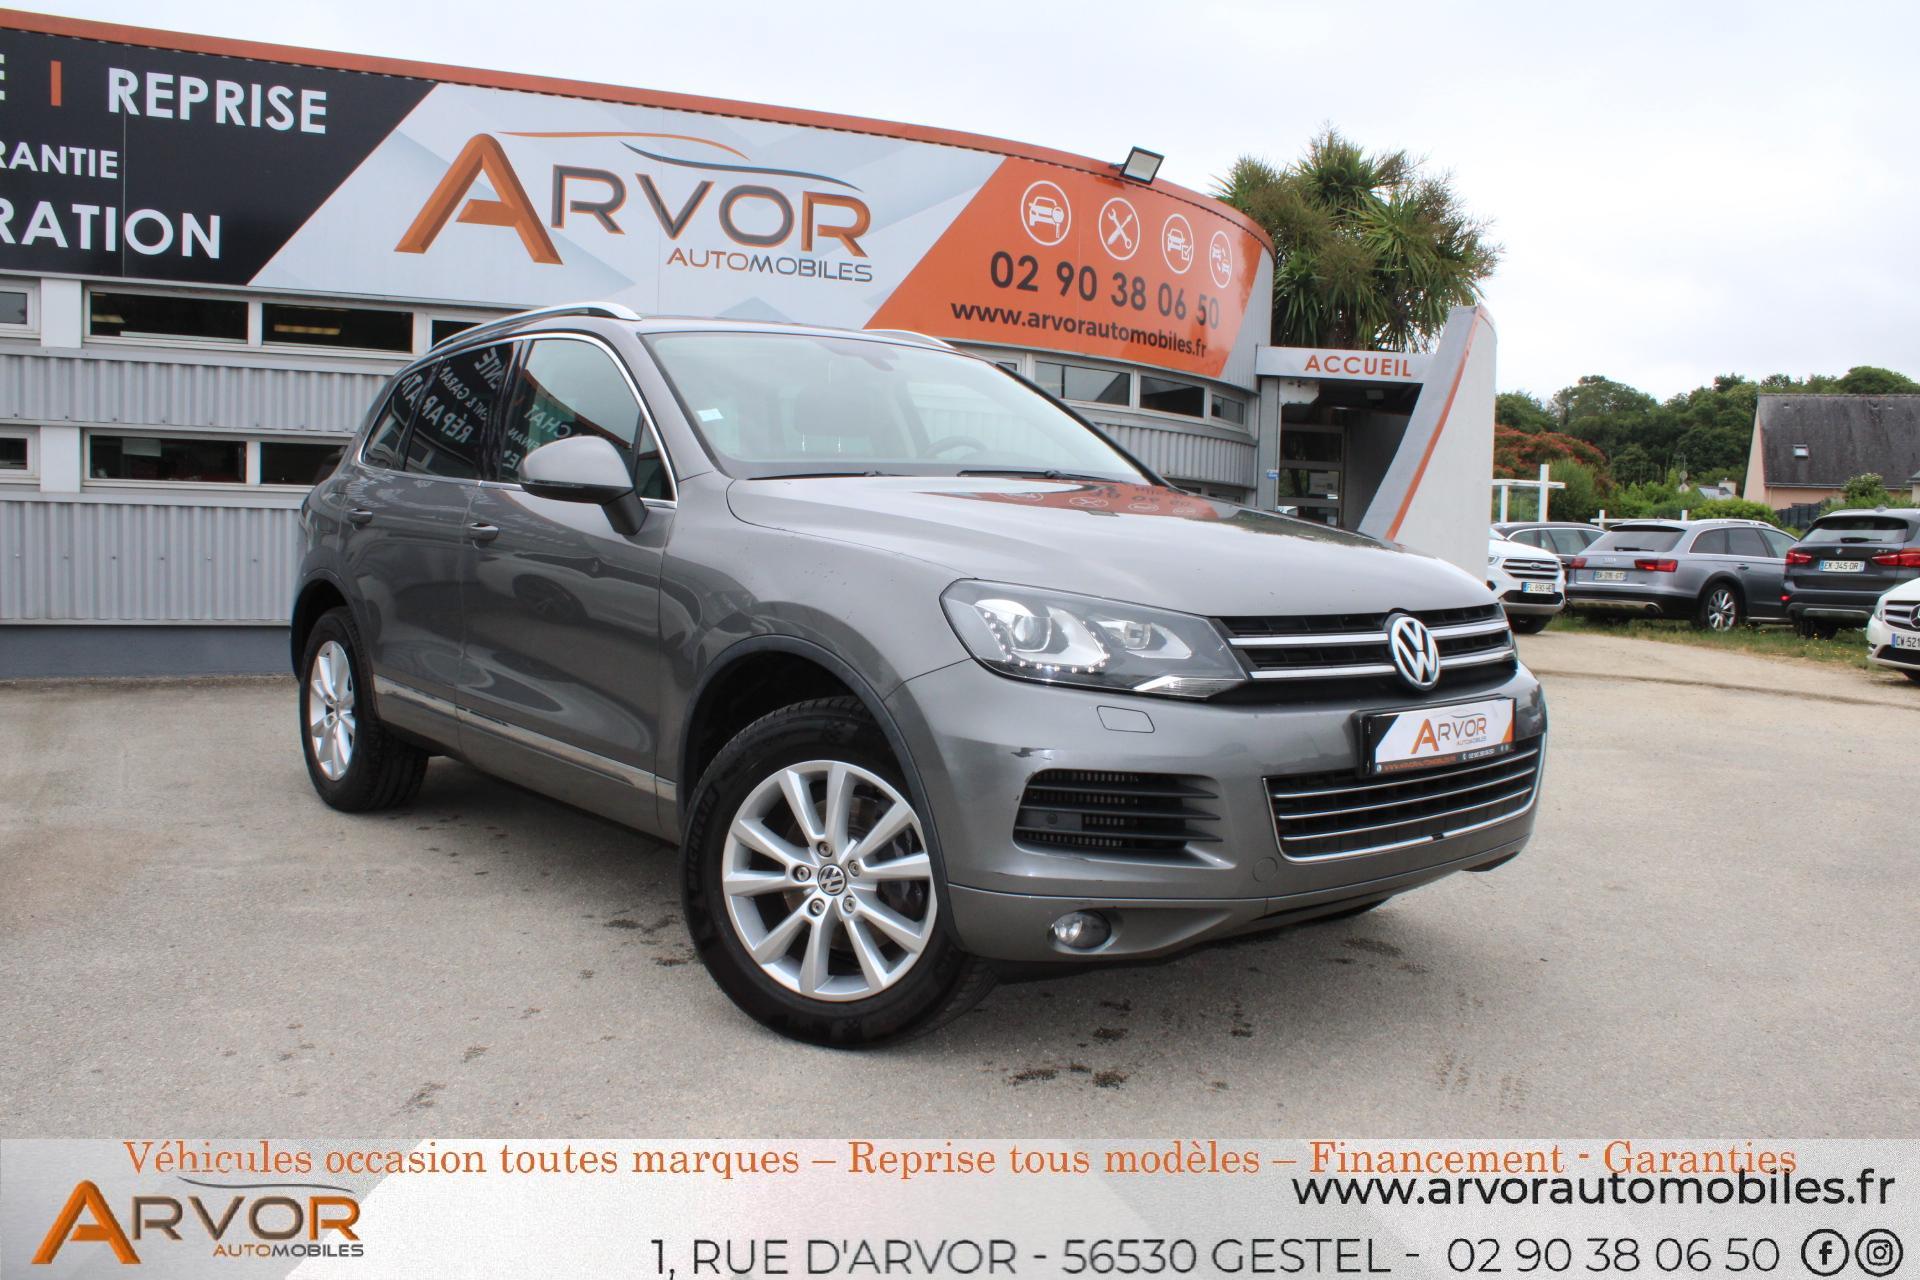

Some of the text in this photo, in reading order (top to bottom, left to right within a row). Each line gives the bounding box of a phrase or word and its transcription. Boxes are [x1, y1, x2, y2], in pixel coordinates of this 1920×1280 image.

[108, 67, 328, 135] REPRISE
[393, 133, 872, 266] ARVOR
[667, 247, 873, 282] AUTOMOBILES
[990, 251, 1220, 330] 02 90 38 06 50
[951, 302, 1208, 358] www.arvorautomobiles.fr
[1304, 354, 1412, 377] ACCUEIL
[1410, 716, 1488, 755] ARVOR
